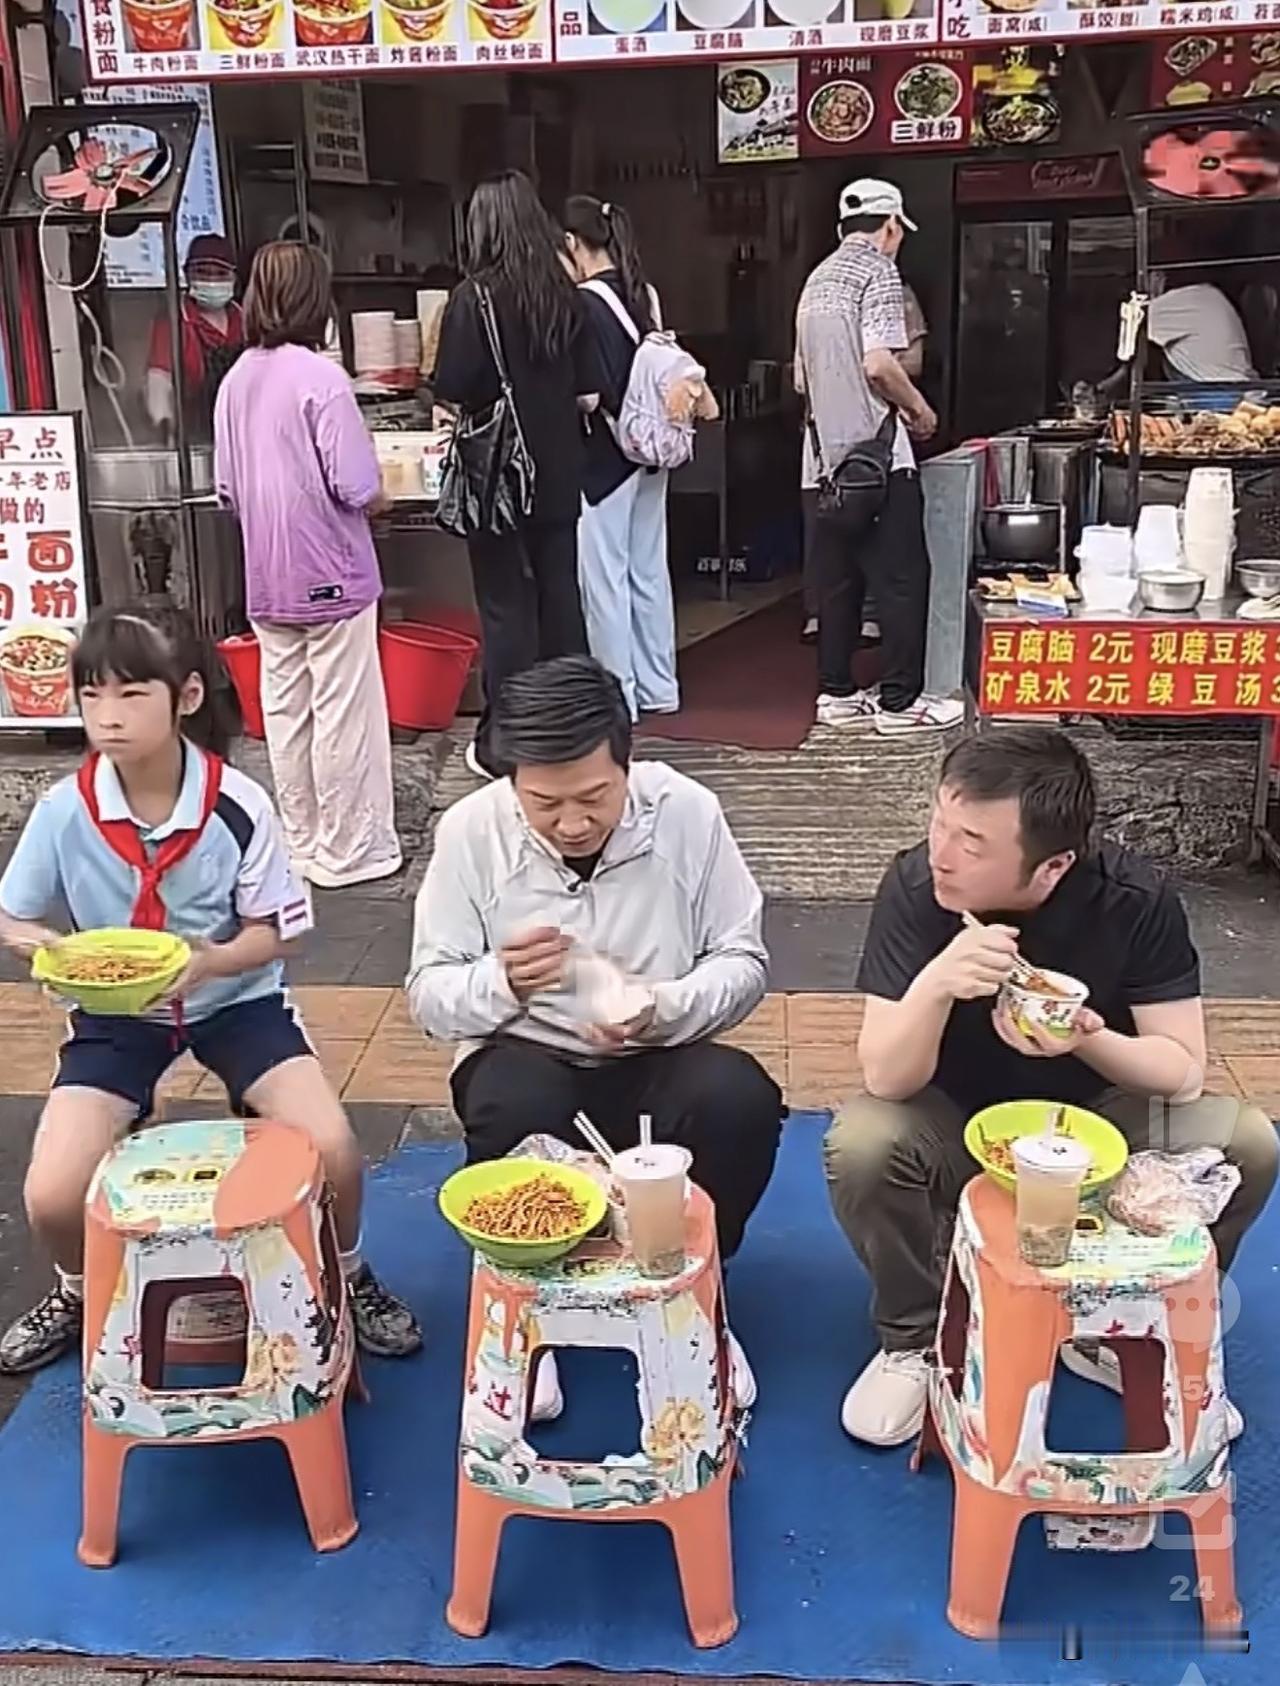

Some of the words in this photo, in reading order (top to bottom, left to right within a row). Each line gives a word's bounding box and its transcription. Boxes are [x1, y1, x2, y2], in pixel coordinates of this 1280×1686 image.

[560, 11, 582, 36] 品
[860, 24, 929, 42] 现磨豆浆
[219, 52, 285, 70] 三鲜粉面
[296, 47, 379, 66] 武汉热干面
[391, 45, 458, 63] 炸酱粉面
[476, 42, 543, 61] 肉丝粉面
[133, 55, 198, 72] 牛肉粉面
[895, 121, 957, 141] 三鲜粉
[0, 470, 71, 491] 年老店
[988, 630, 1076, 663] 豆腐脑
[1089, 632, 1134, 663] 2元
[1150, 629, 1267, 665] 现磨豆浆
[985, 671, 1071, 704] 矿泉水
[1087, 674, 1132, 704] 2元
